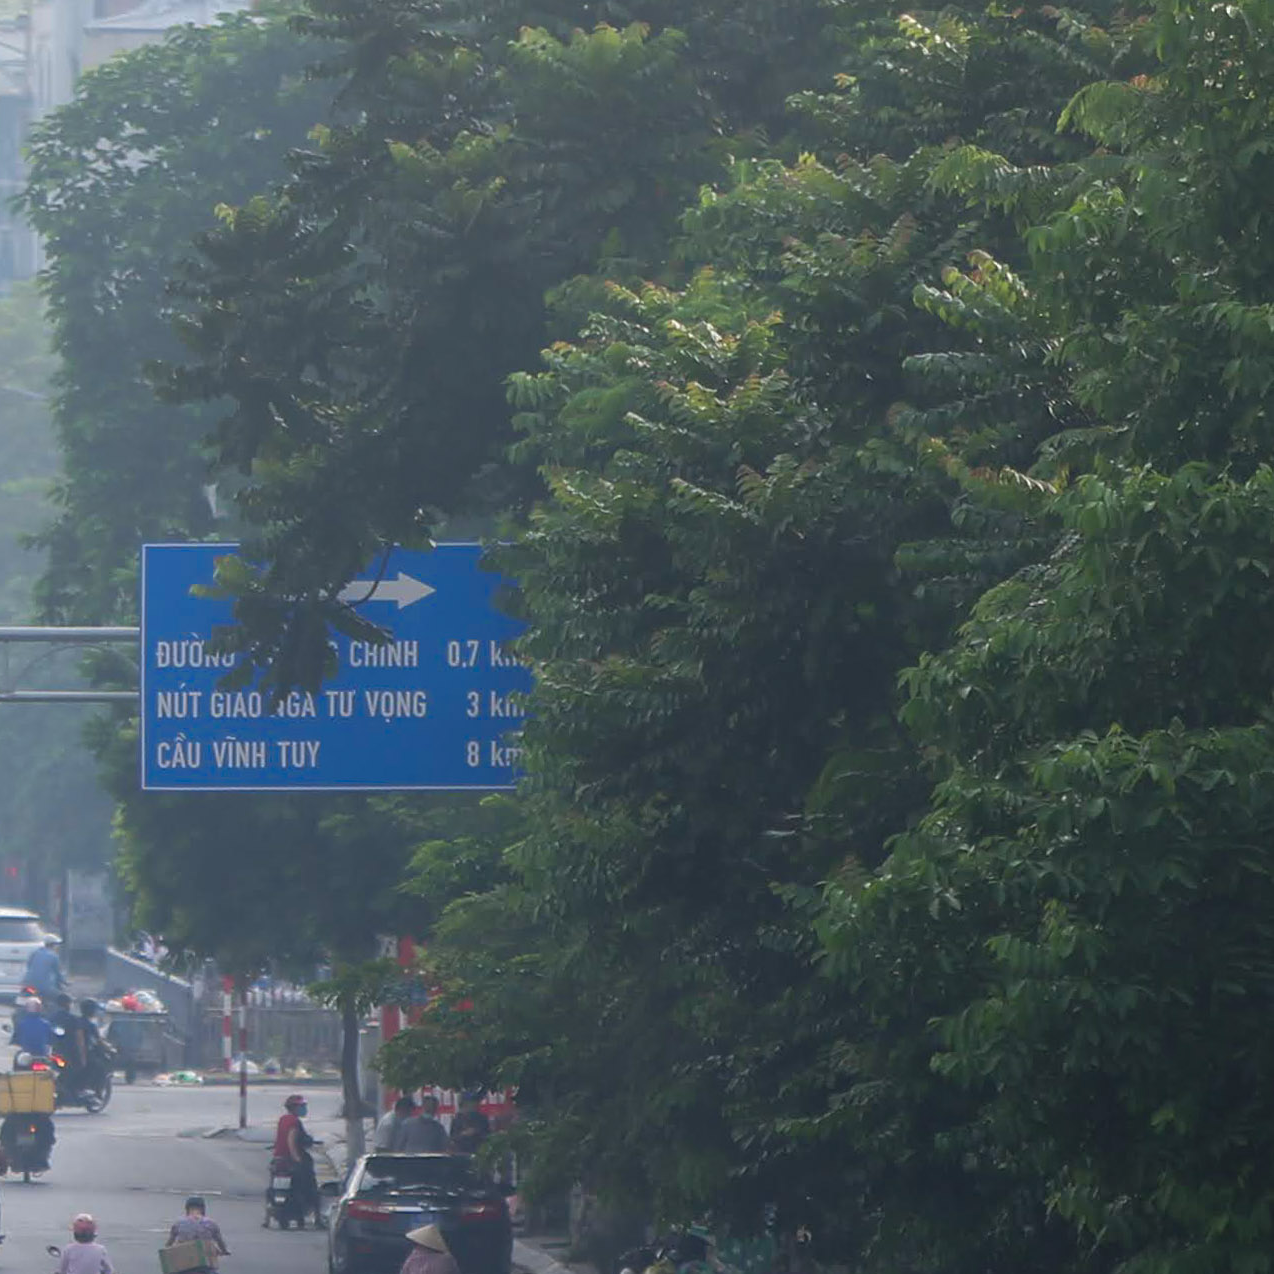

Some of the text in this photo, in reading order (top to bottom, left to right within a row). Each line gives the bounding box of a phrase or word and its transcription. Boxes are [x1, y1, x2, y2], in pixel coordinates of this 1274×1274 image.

[158, 683, 202, 718] NÚT
[211, 692, 262, 718] GIAO
[326, 691, 356, 717] TƯ
[366, 691, 426, 723] VỌNG
[467, 691, 479, 717] 3
[158, 733, 201, 768] CẦU
[213, 736, 266, 768] VĨNH
[277, 741, 320, 767] TUY
[468, 741, 479, 766] 8
